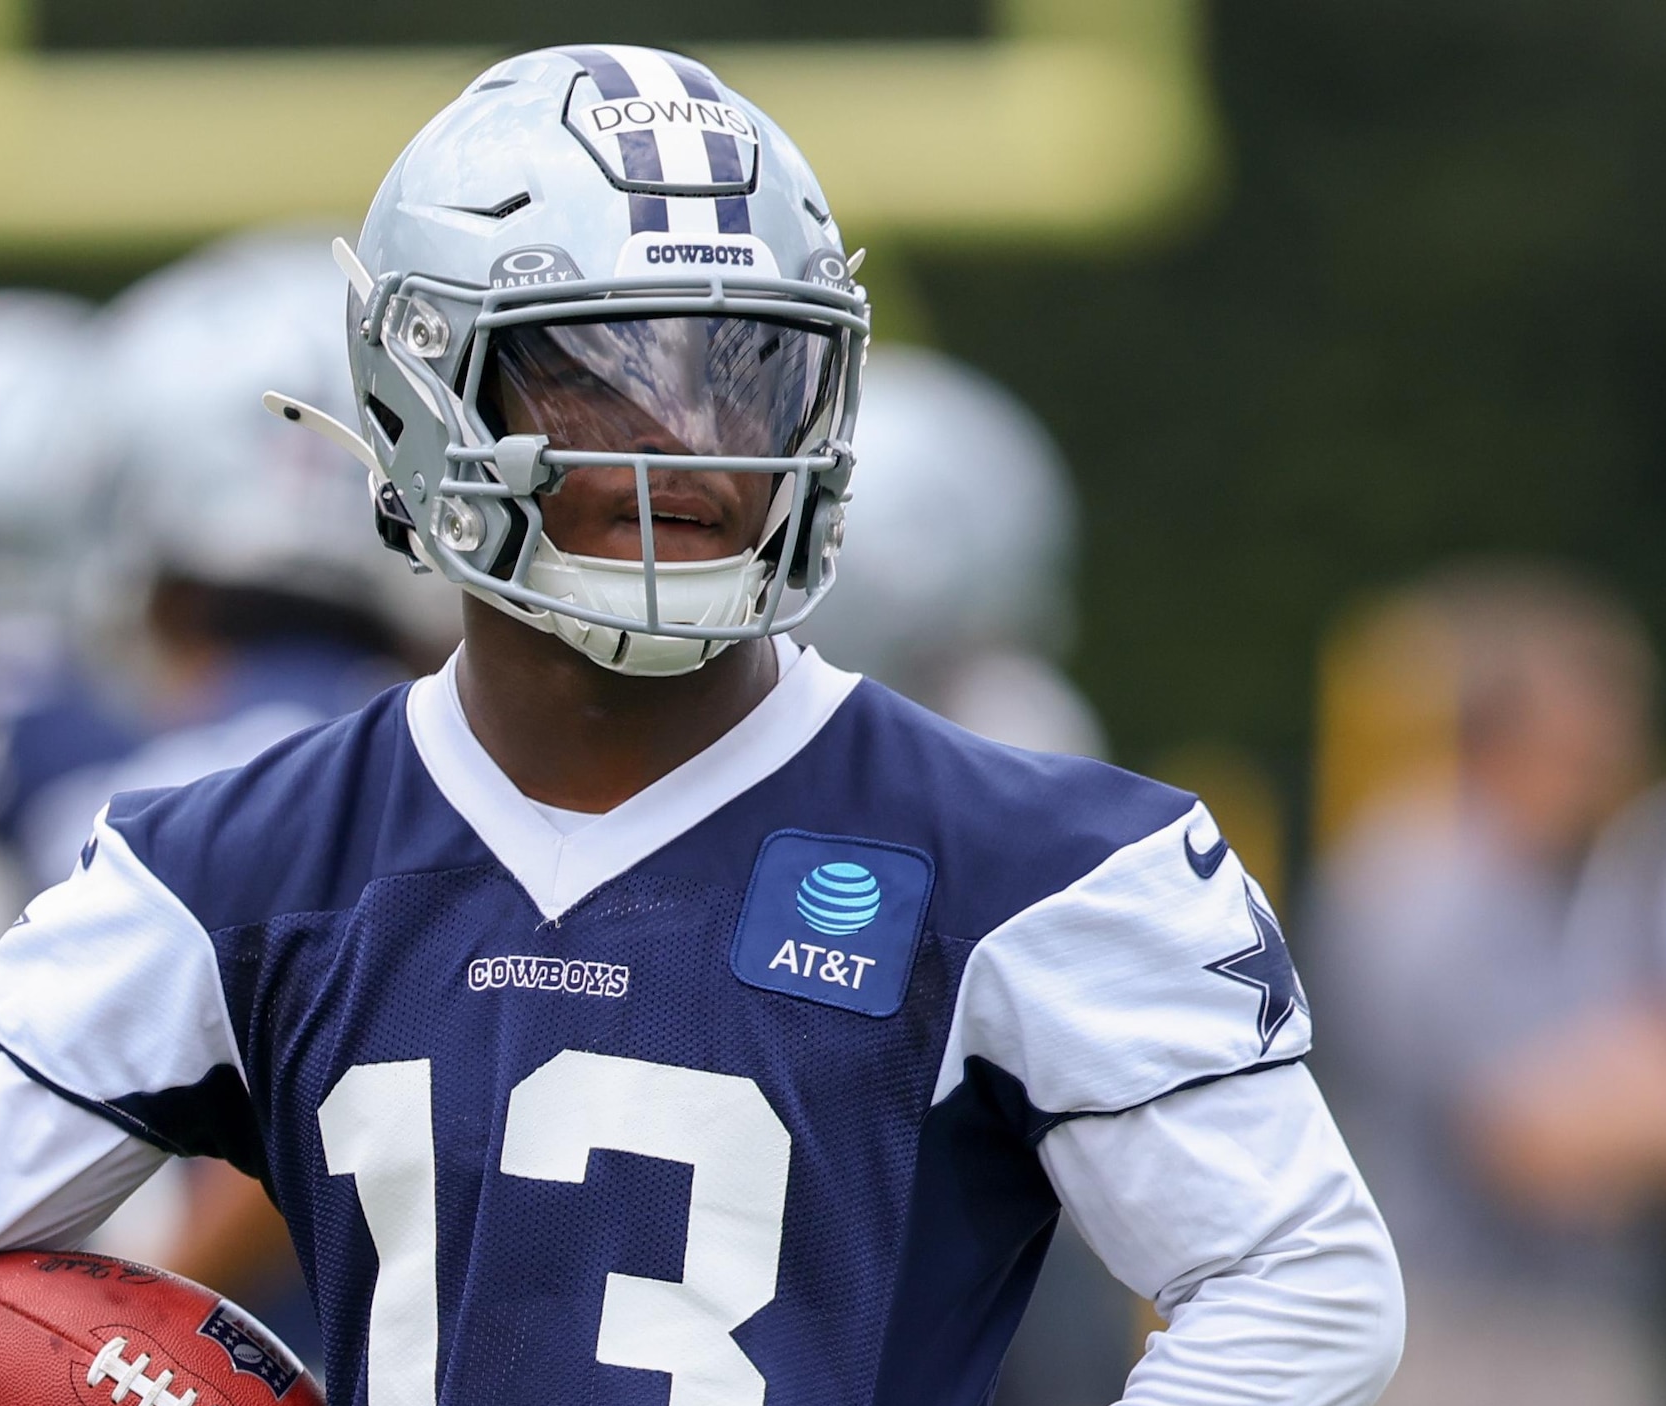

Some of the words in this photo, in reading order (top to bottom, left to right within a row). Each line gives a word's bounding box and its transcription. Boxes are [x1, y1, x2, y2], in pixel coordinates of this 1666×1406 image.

[591, 101, 748, 136] DOWNS
[645, 244, 754, 267] COWBOYS
[467, 953, 630, 998] COWBOYS
[768, 939, 877, 990] AT&T
